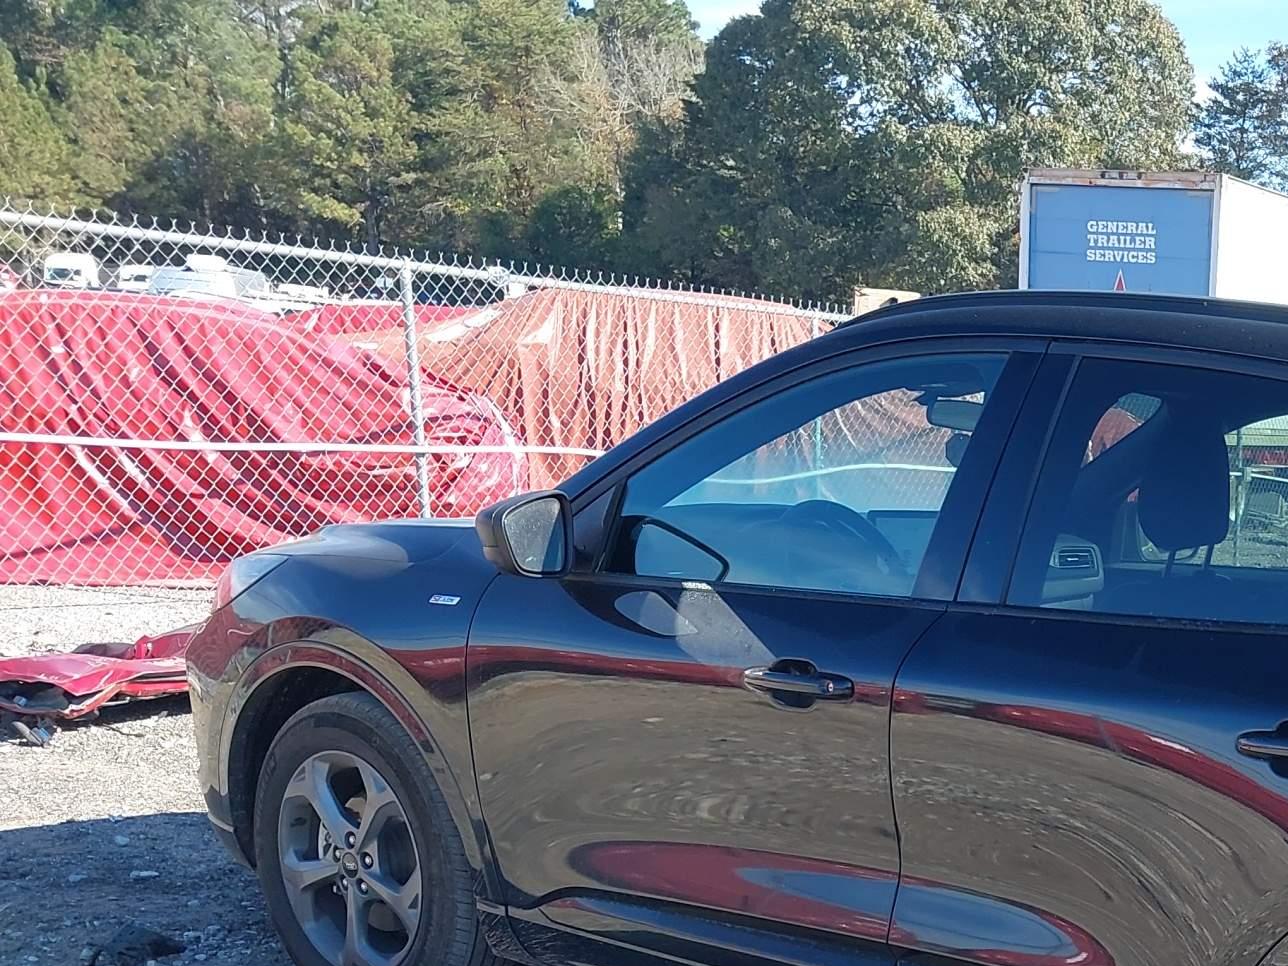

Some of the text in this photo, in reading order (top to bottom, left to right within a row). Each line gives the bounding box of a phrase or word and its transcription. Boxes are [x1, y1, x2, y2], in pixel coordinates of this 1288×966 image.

[1086, 221, 1156, 235] GENERAL
[1087, 235, 1156, 249] TRAILER
[1086, 249, 1156, 264] SERVICES
